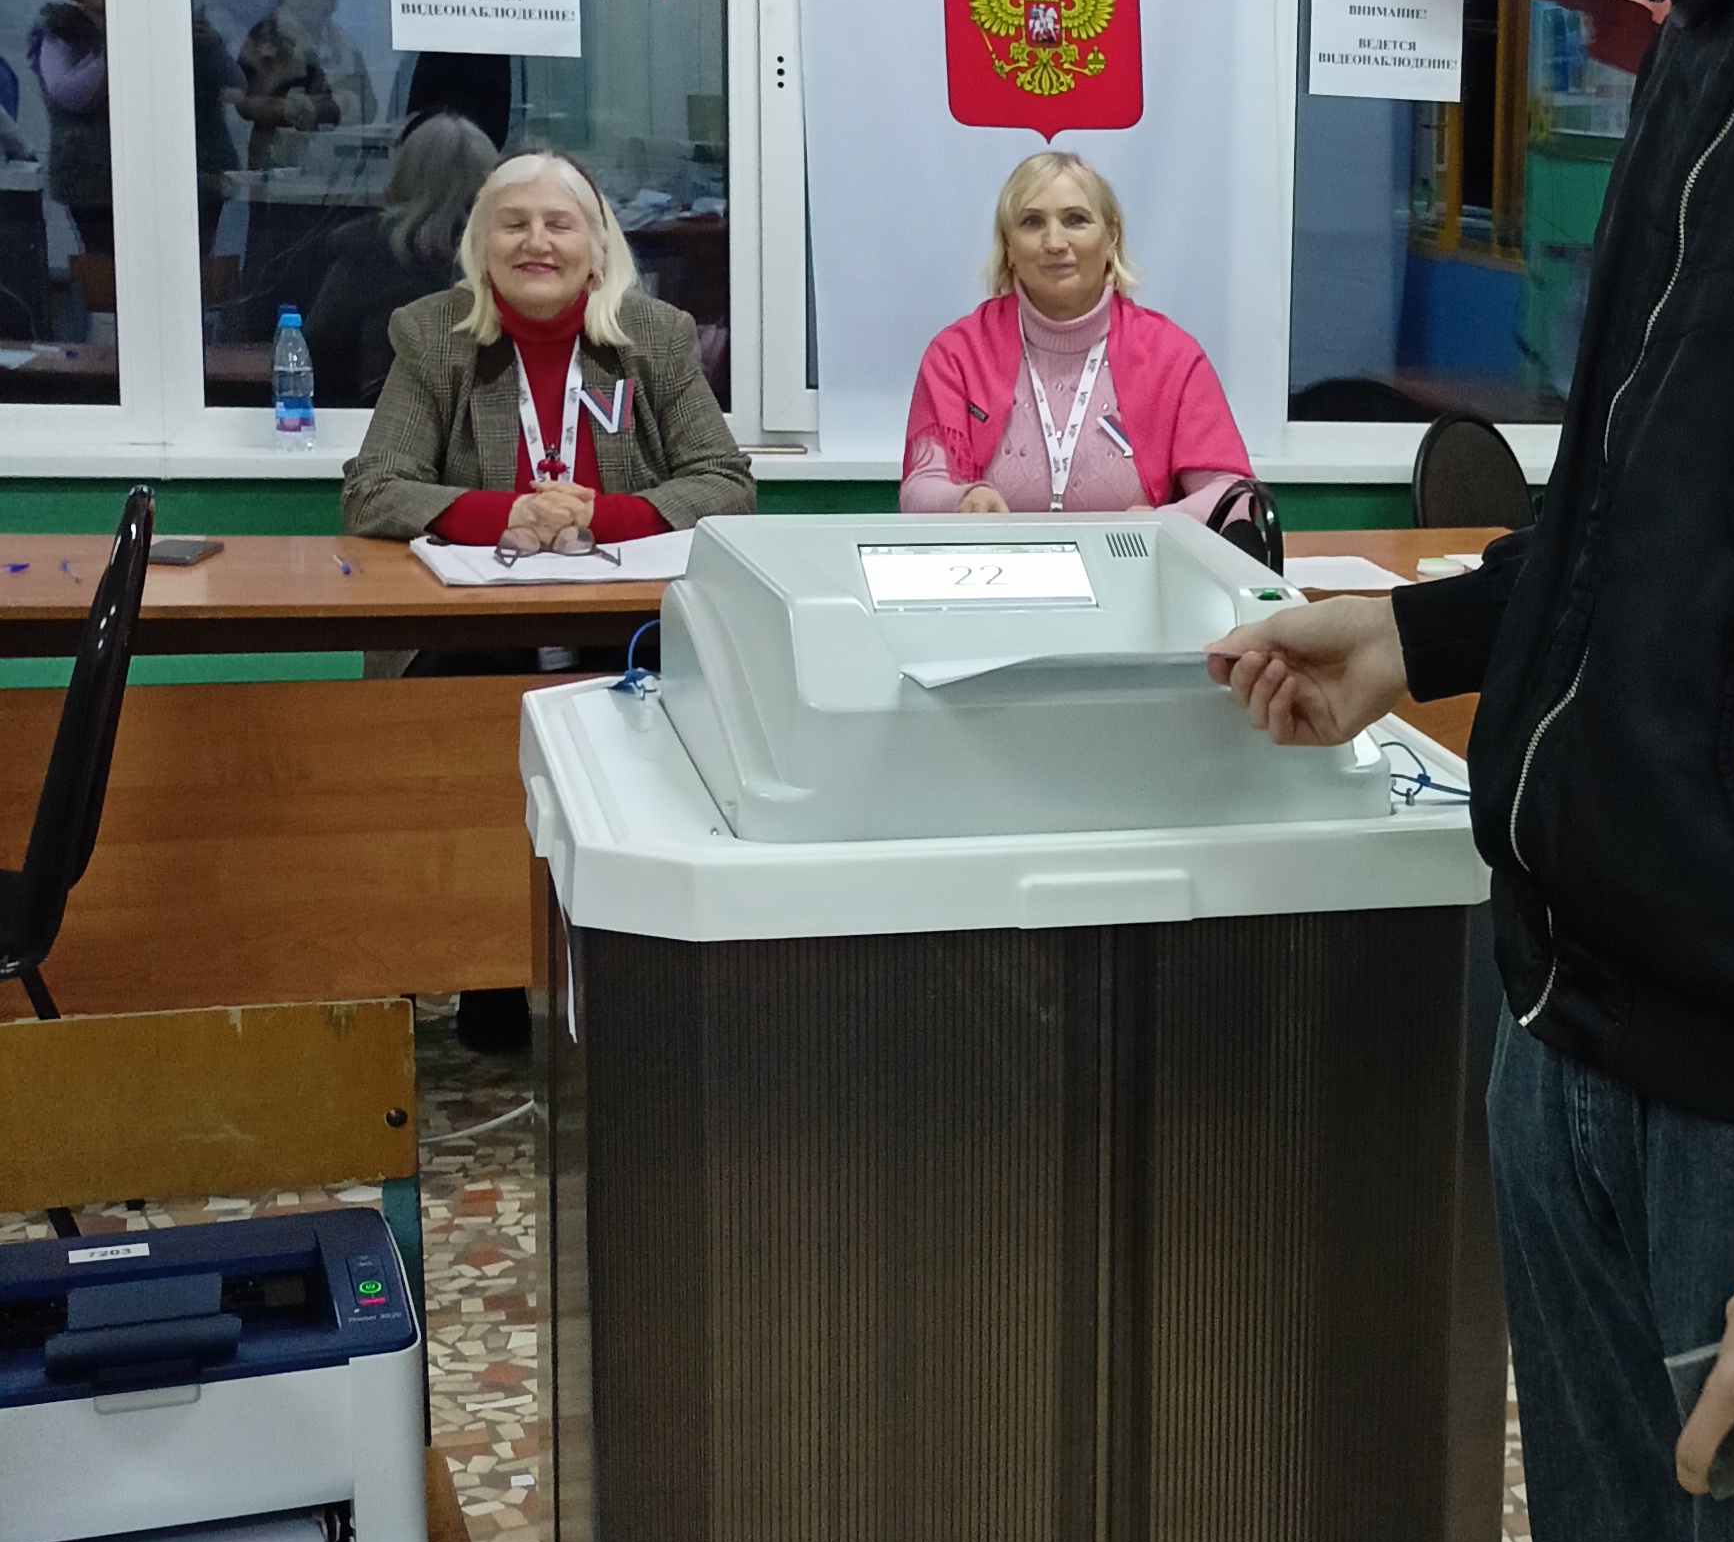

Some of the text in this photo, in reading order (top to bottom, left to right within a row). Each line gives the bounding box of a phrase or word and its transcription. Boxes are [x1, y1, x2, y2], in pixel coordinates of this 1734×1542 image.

[401, 2, 576, 22] ВИДЕОНАБЛЮДЕНИЕ!
[1349, 5, 1428, 20] ВНИМАНИЕ!
[1358, 38, 1417, 52] ВЕДЕТСЯ
[1318, 52, 1458, 71] ВИДЕОНАБЛЮДЕНИЕ!
[949, 565, 1008, 586] 22
